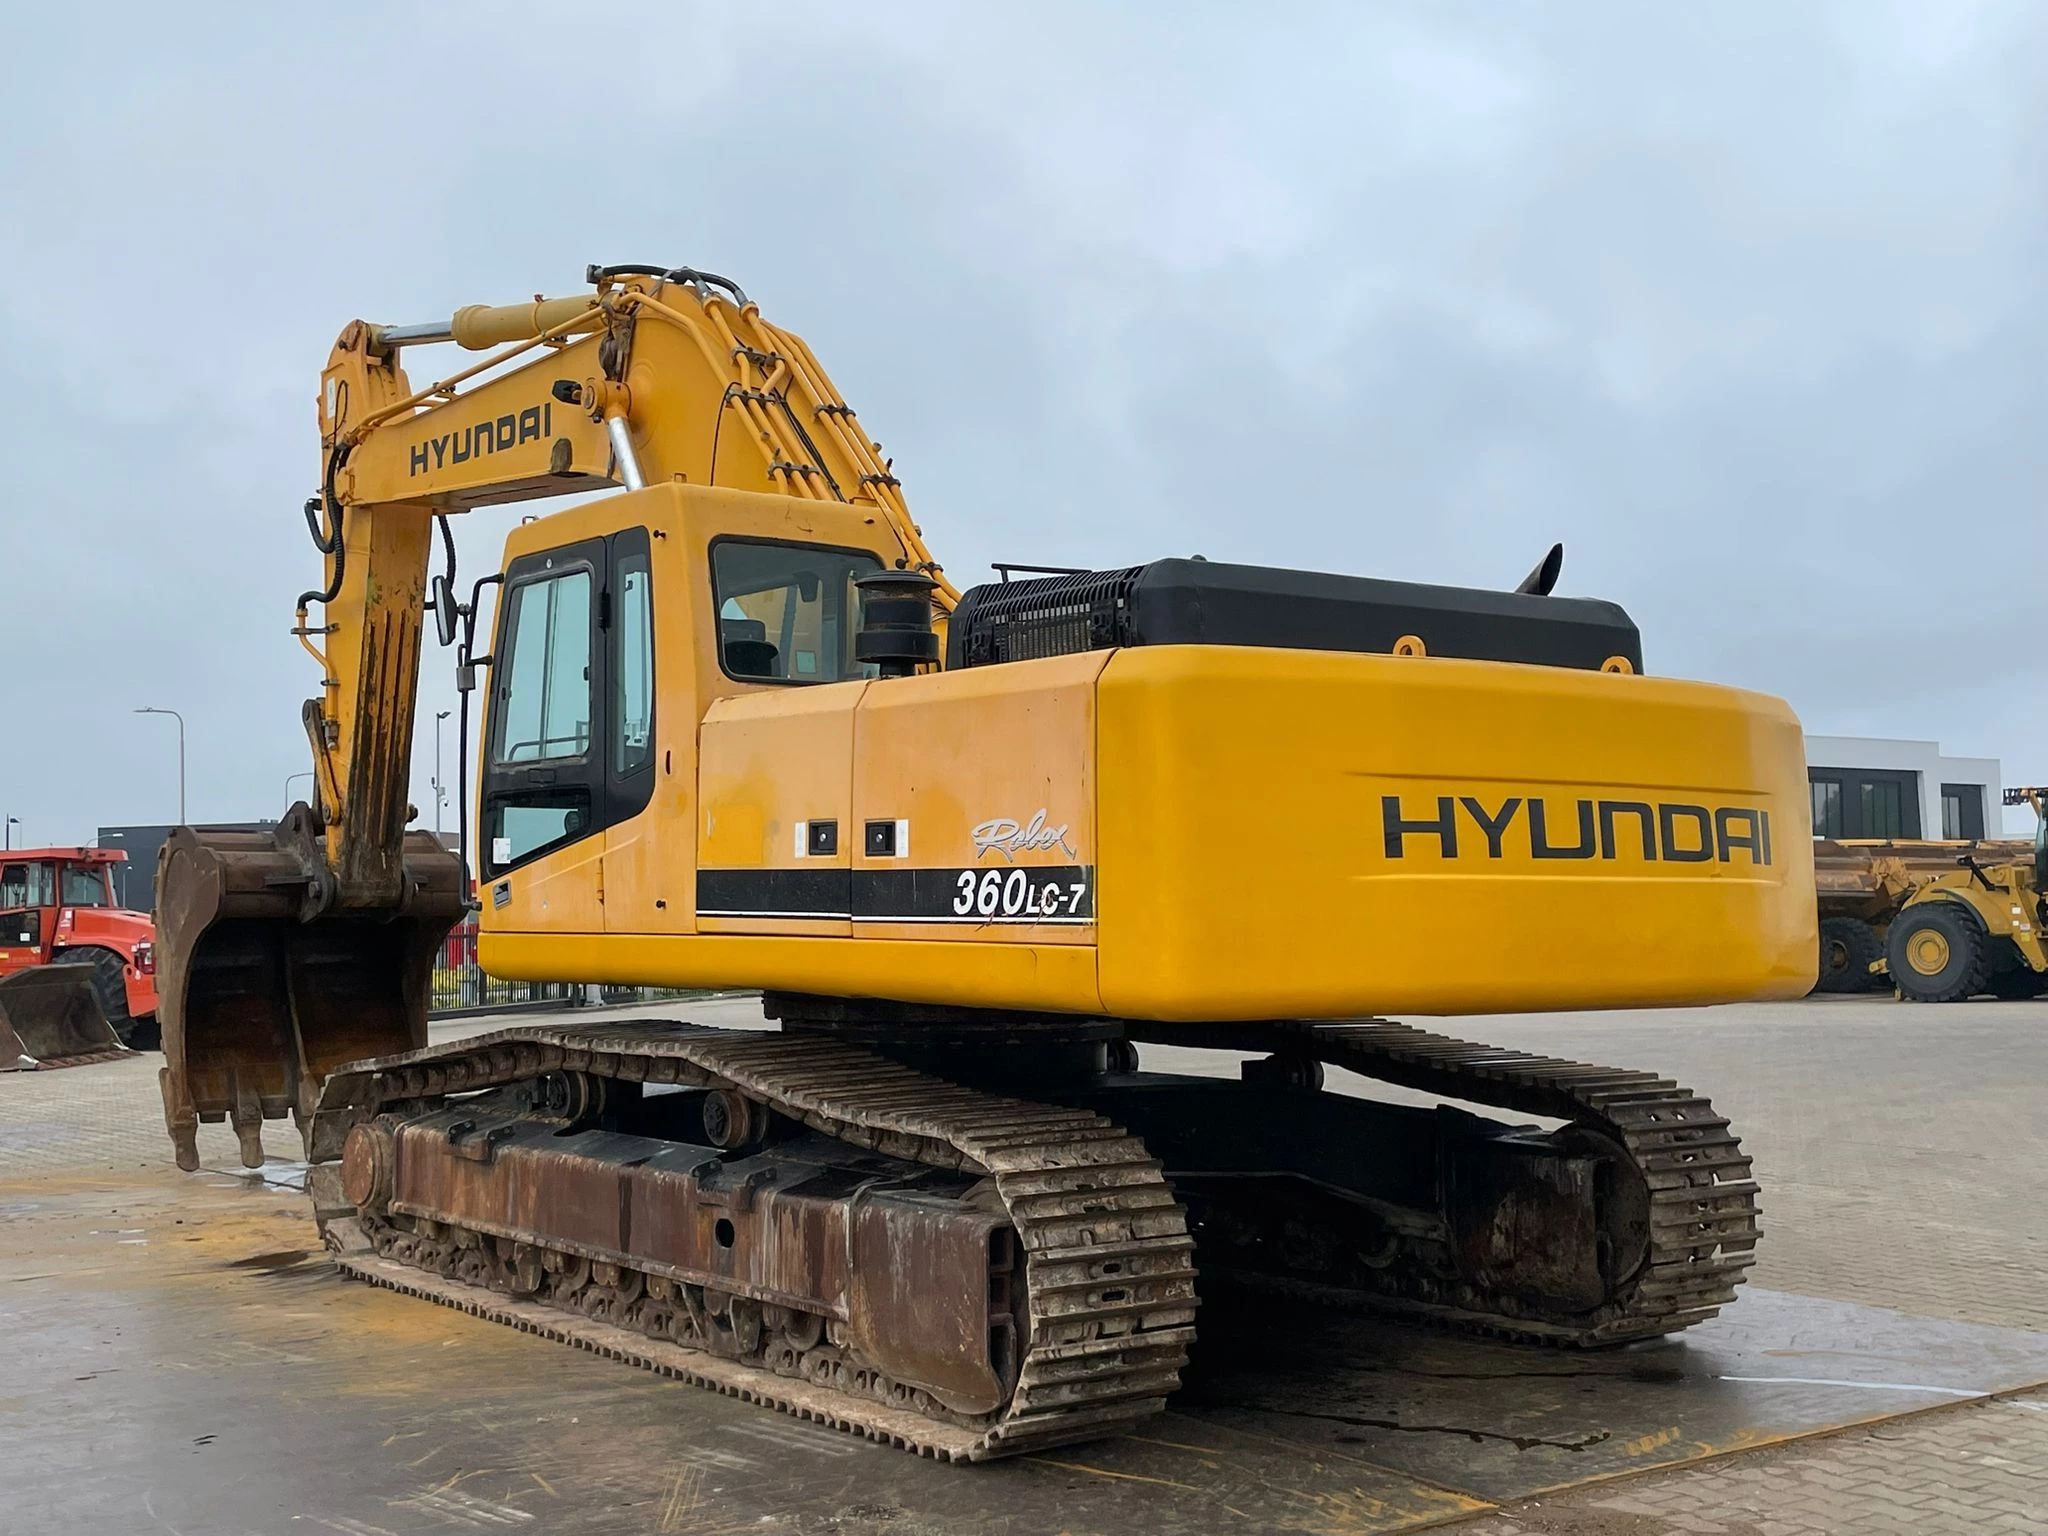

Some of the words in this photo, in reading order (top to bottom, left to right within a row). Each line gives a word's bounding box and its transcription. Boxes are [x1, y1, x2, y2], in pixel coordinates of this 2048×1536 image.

[410, 402, 551, 477] HYUNDAI
[1381, 796, 1771, 866] HYUNDAI
[953, 869, 1086, 915] 360LC-7
